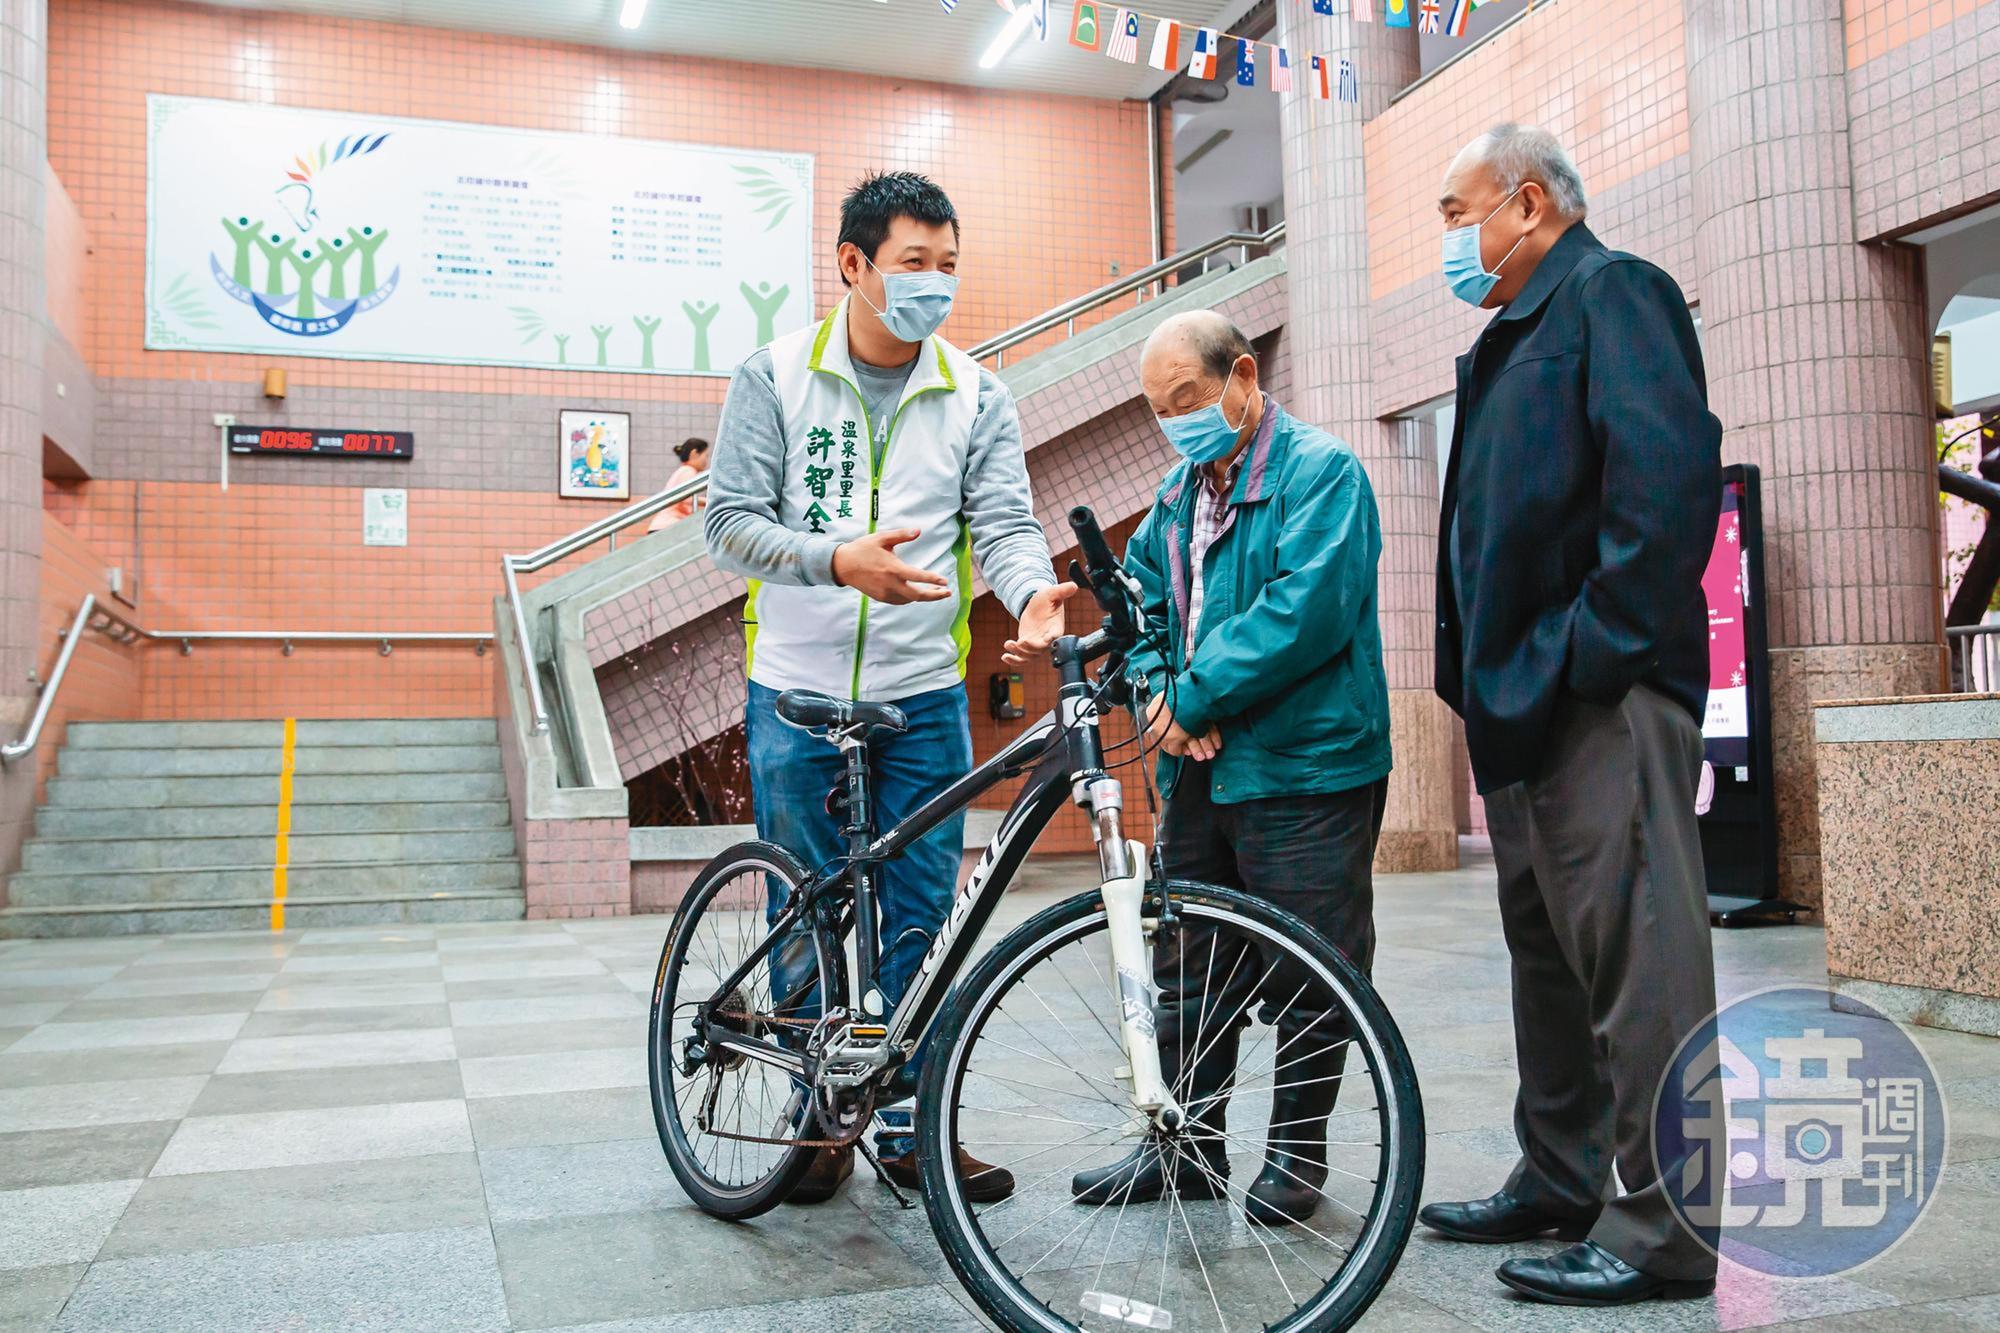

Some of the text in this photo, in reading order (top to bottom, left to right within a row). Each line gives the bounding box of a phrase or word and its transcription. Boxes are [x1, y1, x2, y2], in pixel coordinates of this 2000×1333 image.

[260, 430, 313, 450] 0096
[343, 433, 396, 452] 0077
[803, 426, 836, 534] 許智全
[922, 831, 1002, 974] GIANT
